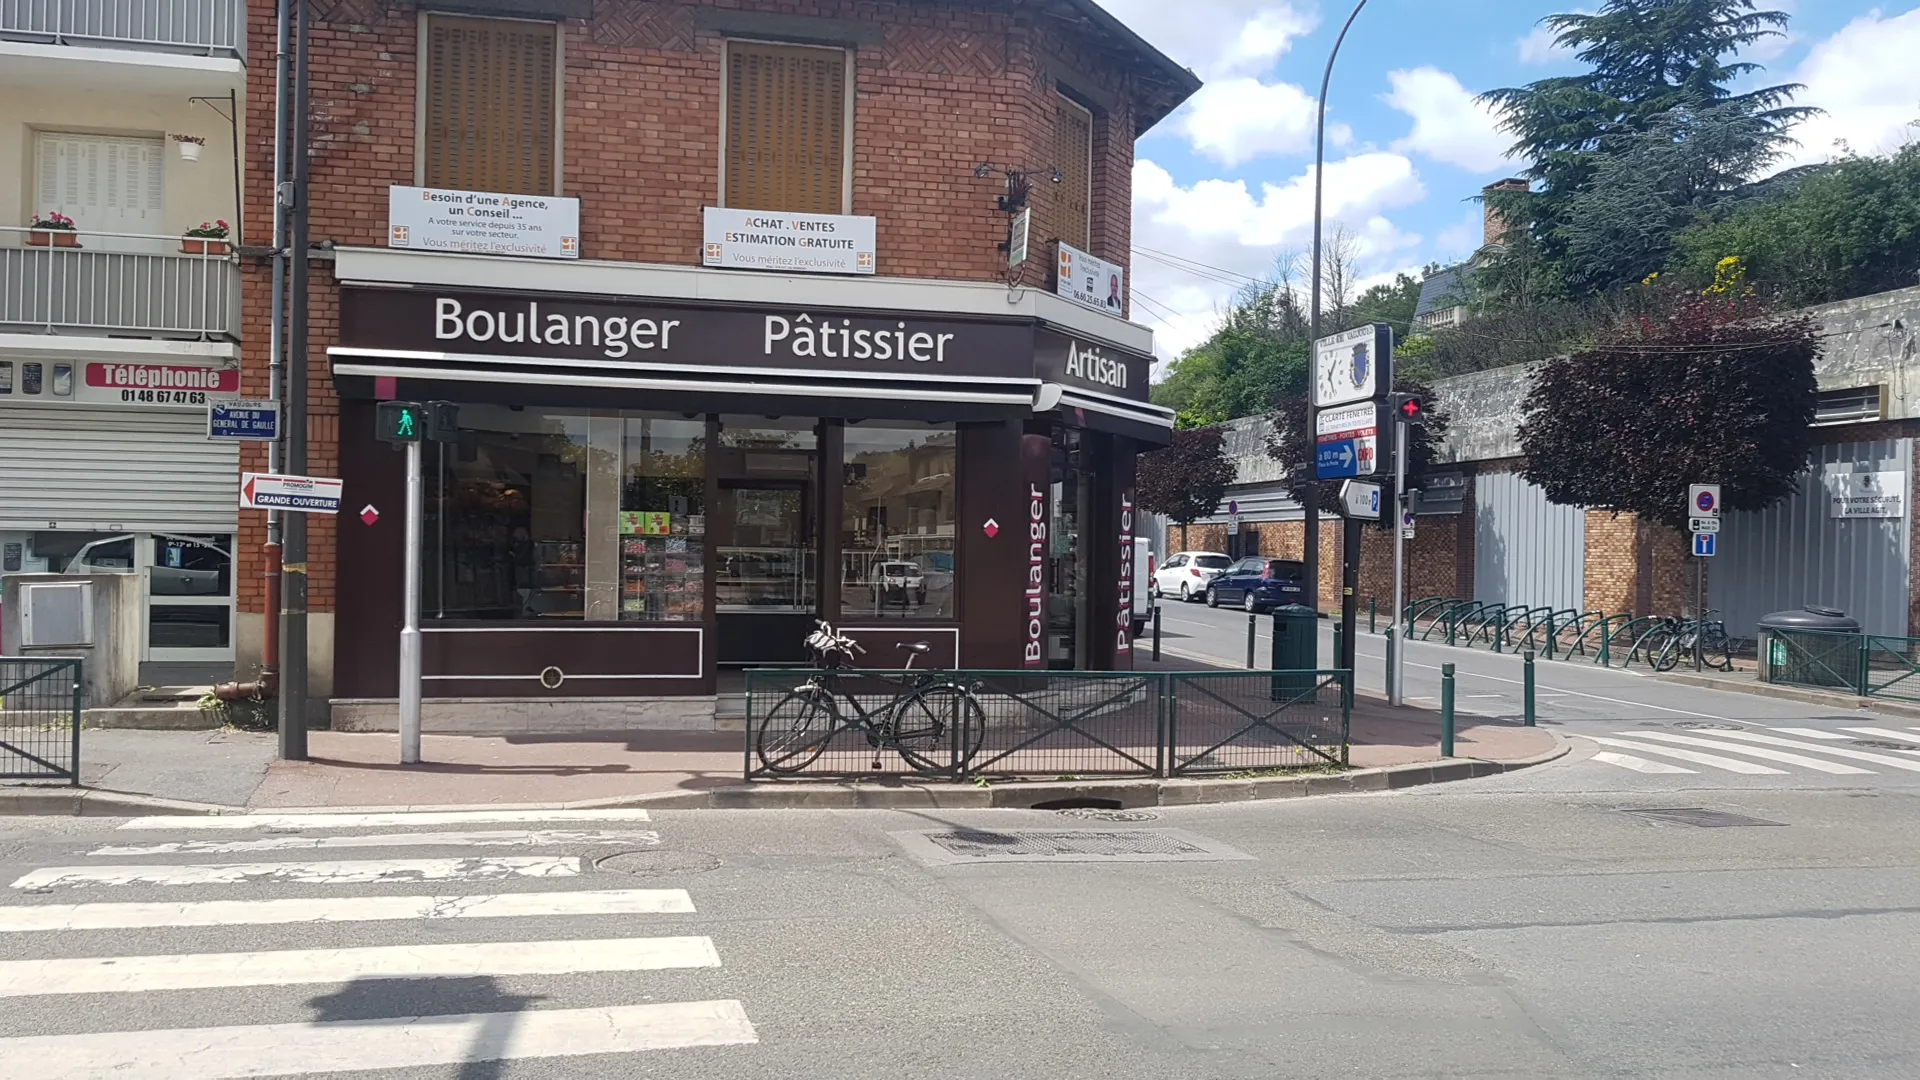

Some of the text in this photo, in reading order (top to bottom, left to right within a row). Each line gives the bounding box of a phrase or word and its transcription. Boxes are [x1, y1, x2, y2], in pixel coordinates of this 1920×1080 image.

[423, 191, 463, 204] Besoin
[502, 196, 549, 211] Agence,
[449, 207, 464, 216] un
[467, 206, 510, 219] Conseil
[428, 217, 542, 232] A votre service depuis 35 ans
[745, 217, 784, 230] ACHAT
[792, 220, 835, 233] VENTES
[466, 229, 487, 238] votre
[488, 231, 520, 240] secteur.
[725, 232, 854, 250] ESTIMATION GRATUITE
[422, 237, 448, 248] Vous
[450, 238, 488, 251] méritez
[733, 252, 756, 264] Vous
[758, 254, 793, 266] méritez
[435, 297, 955, 363] Boulanger Pâtissier
[1065, 340, 1128, 389] Artisan
[103, 364, 220, 389] Téléphonie
[121, 389, 205, 404] 01 48 67 47 63
[229, 411, 260, 419] AVENUE DU
[241, 420, 249, 429] DE
[252, 421, 275, 430] GAULLE
[257, 495, 337, 508] GRANDE OUVERTURE
[1850, 496, 1871, 504] VOTRE
[1025, 483, 1046, 663] Boulanger
[1117, 493, 1134, 652] Pâtissier
